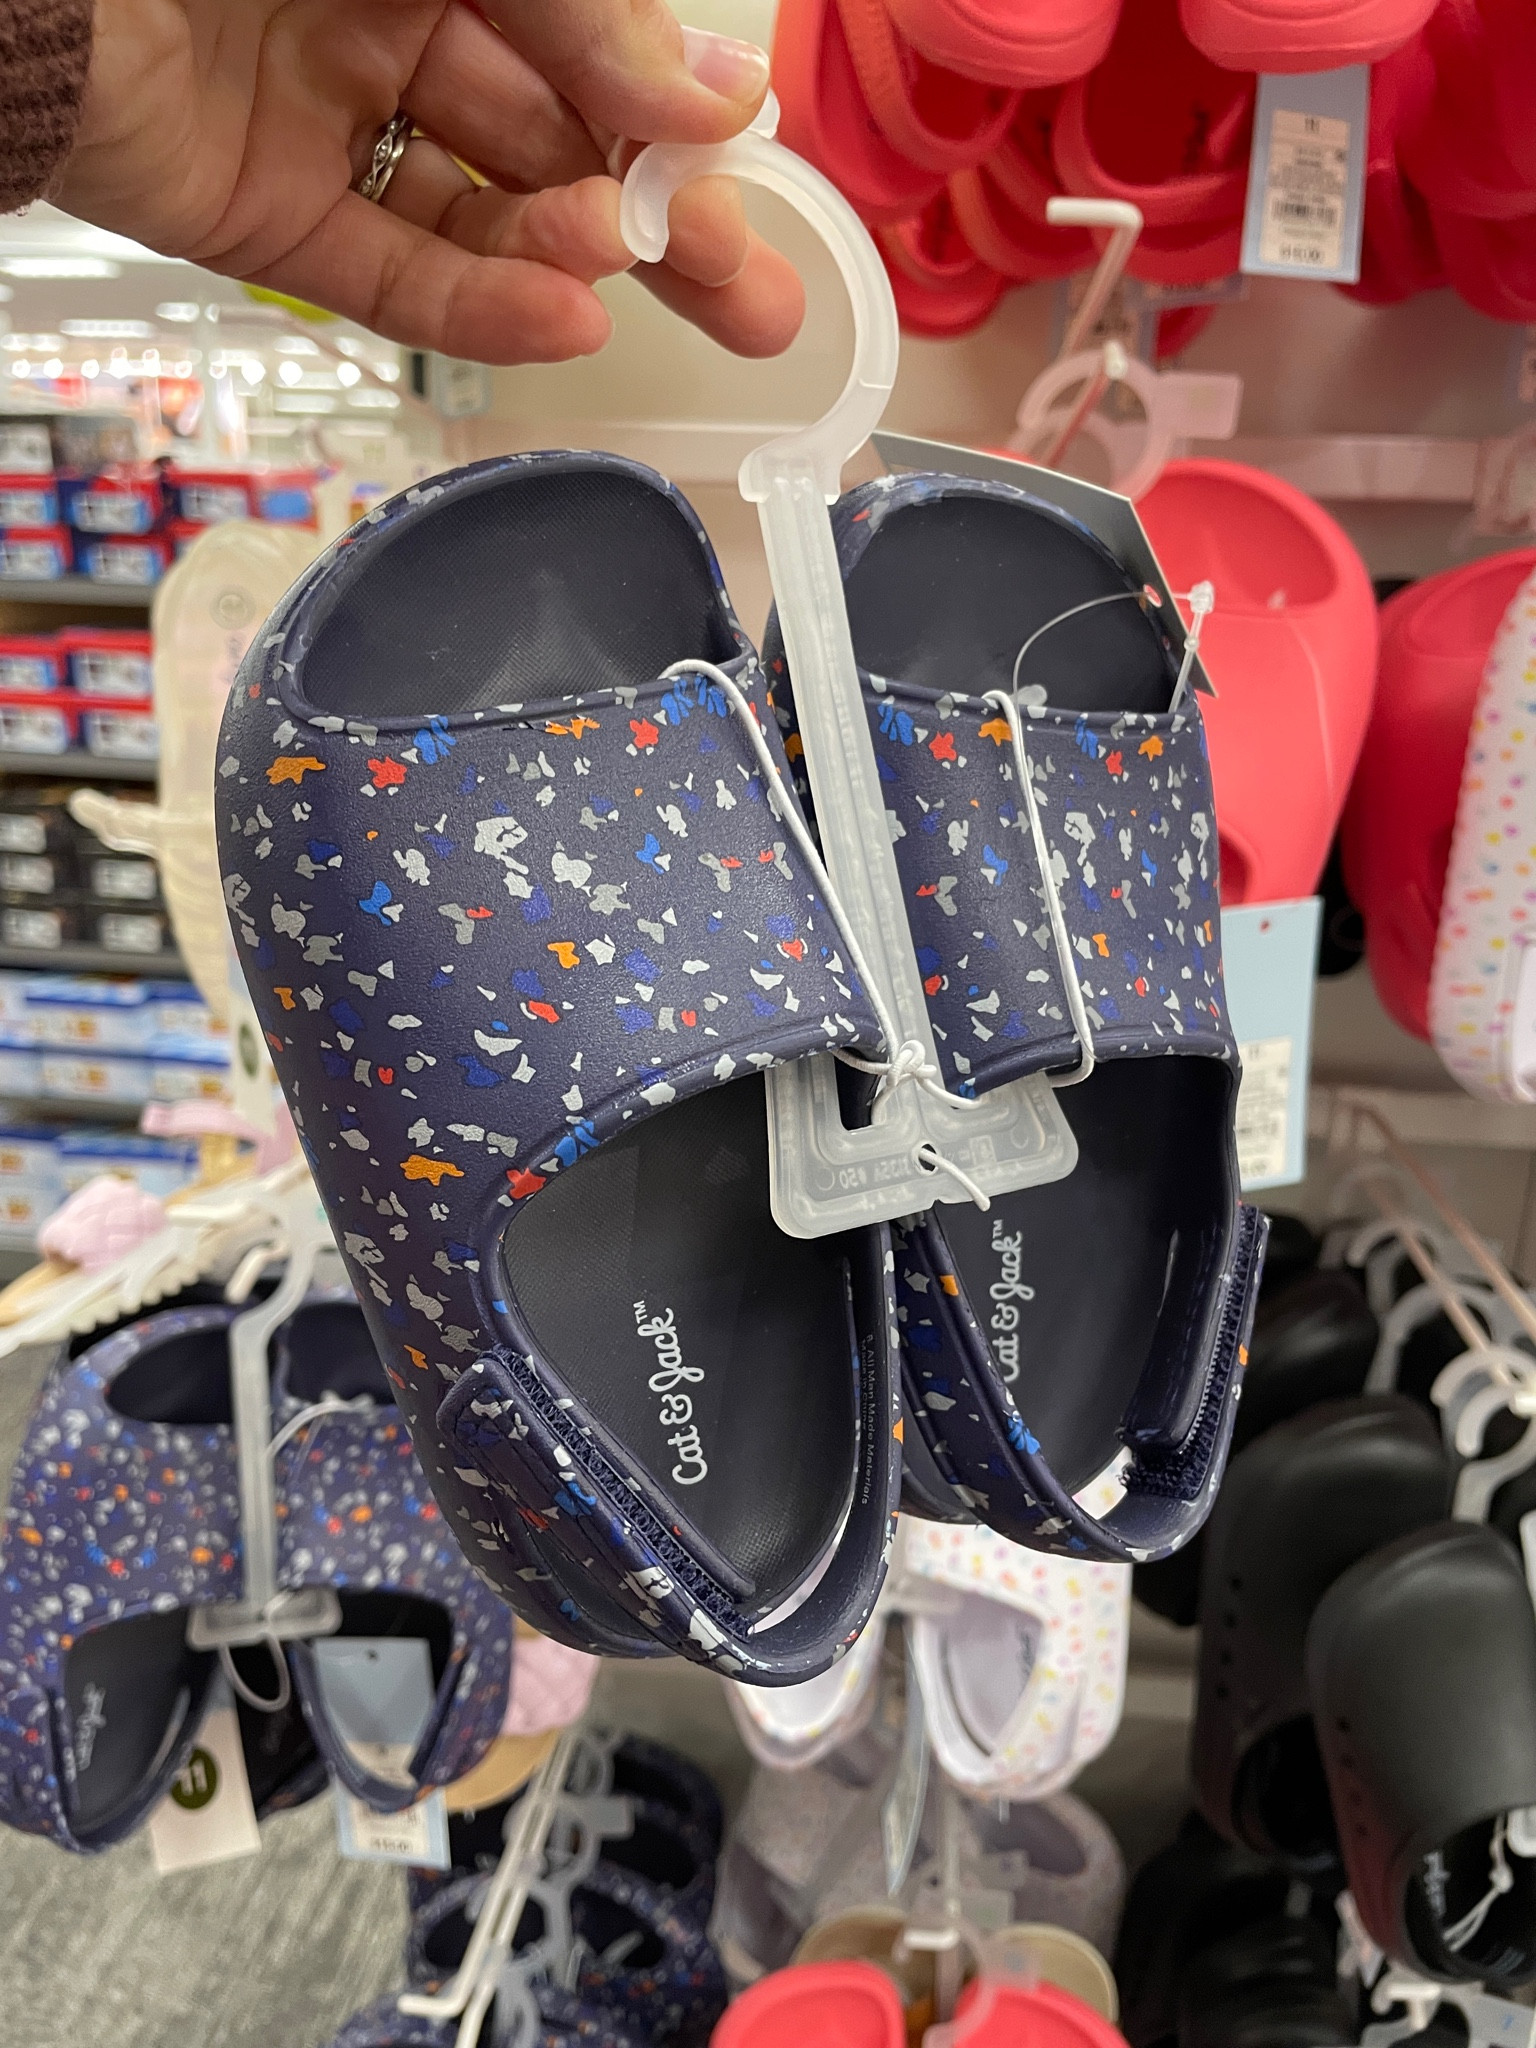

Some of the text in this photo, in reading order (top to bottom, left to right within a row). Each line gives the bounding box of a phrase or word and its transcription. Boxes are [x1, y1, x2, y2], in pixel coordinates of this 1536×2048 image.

[990, 1303, 1020, 1331] &
[867, 1349, 875, 1367] All
[867, 1370, 876, 1399] Man
[659, 1393, 693, 1425] &
[867, 1403, 876, 1440] Made
[667, 1424, 708, 1485] Cat
[861, 1444, 875, 1505] Materials
